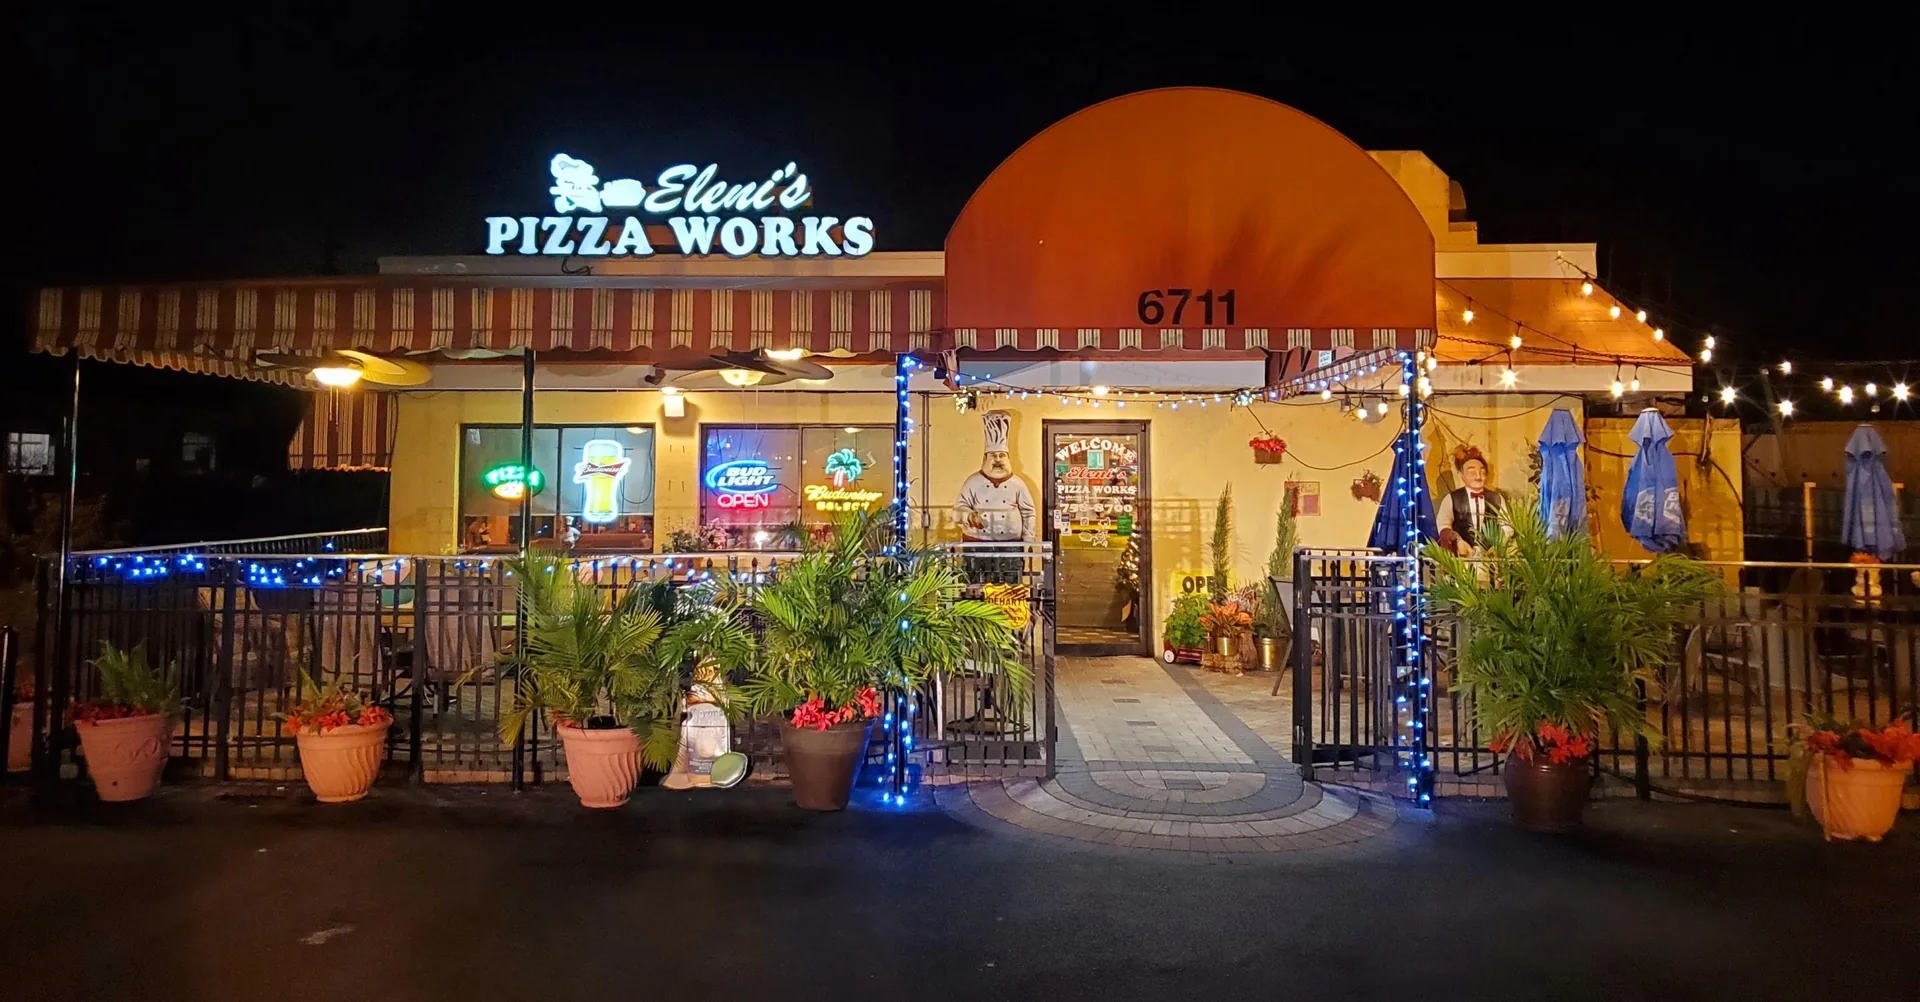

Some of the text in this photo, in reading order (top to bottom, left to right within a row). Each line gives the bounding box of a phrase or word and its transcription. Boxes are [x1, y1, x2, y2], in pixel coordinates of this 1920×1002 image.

[645, 161, 811, 213] Eleni's
[485, 216, 875, 257] PIZZA WORKS
[1138, 289, 1235, 326] 6711
[1055, 437, 1137, 463] WELCOME
[726, 466, 767, 477] BUD
[1066, 467, 1127, 480] Eleni's
[717, 476, 775, 487] LIGHT
[804, 485, 882, 501] Budweiser
[1057, 485, 1137, 495] PIZZA WORKS
[717, 493, 768, 507] OPEN
[816, 501, 869, 512] SELECT
